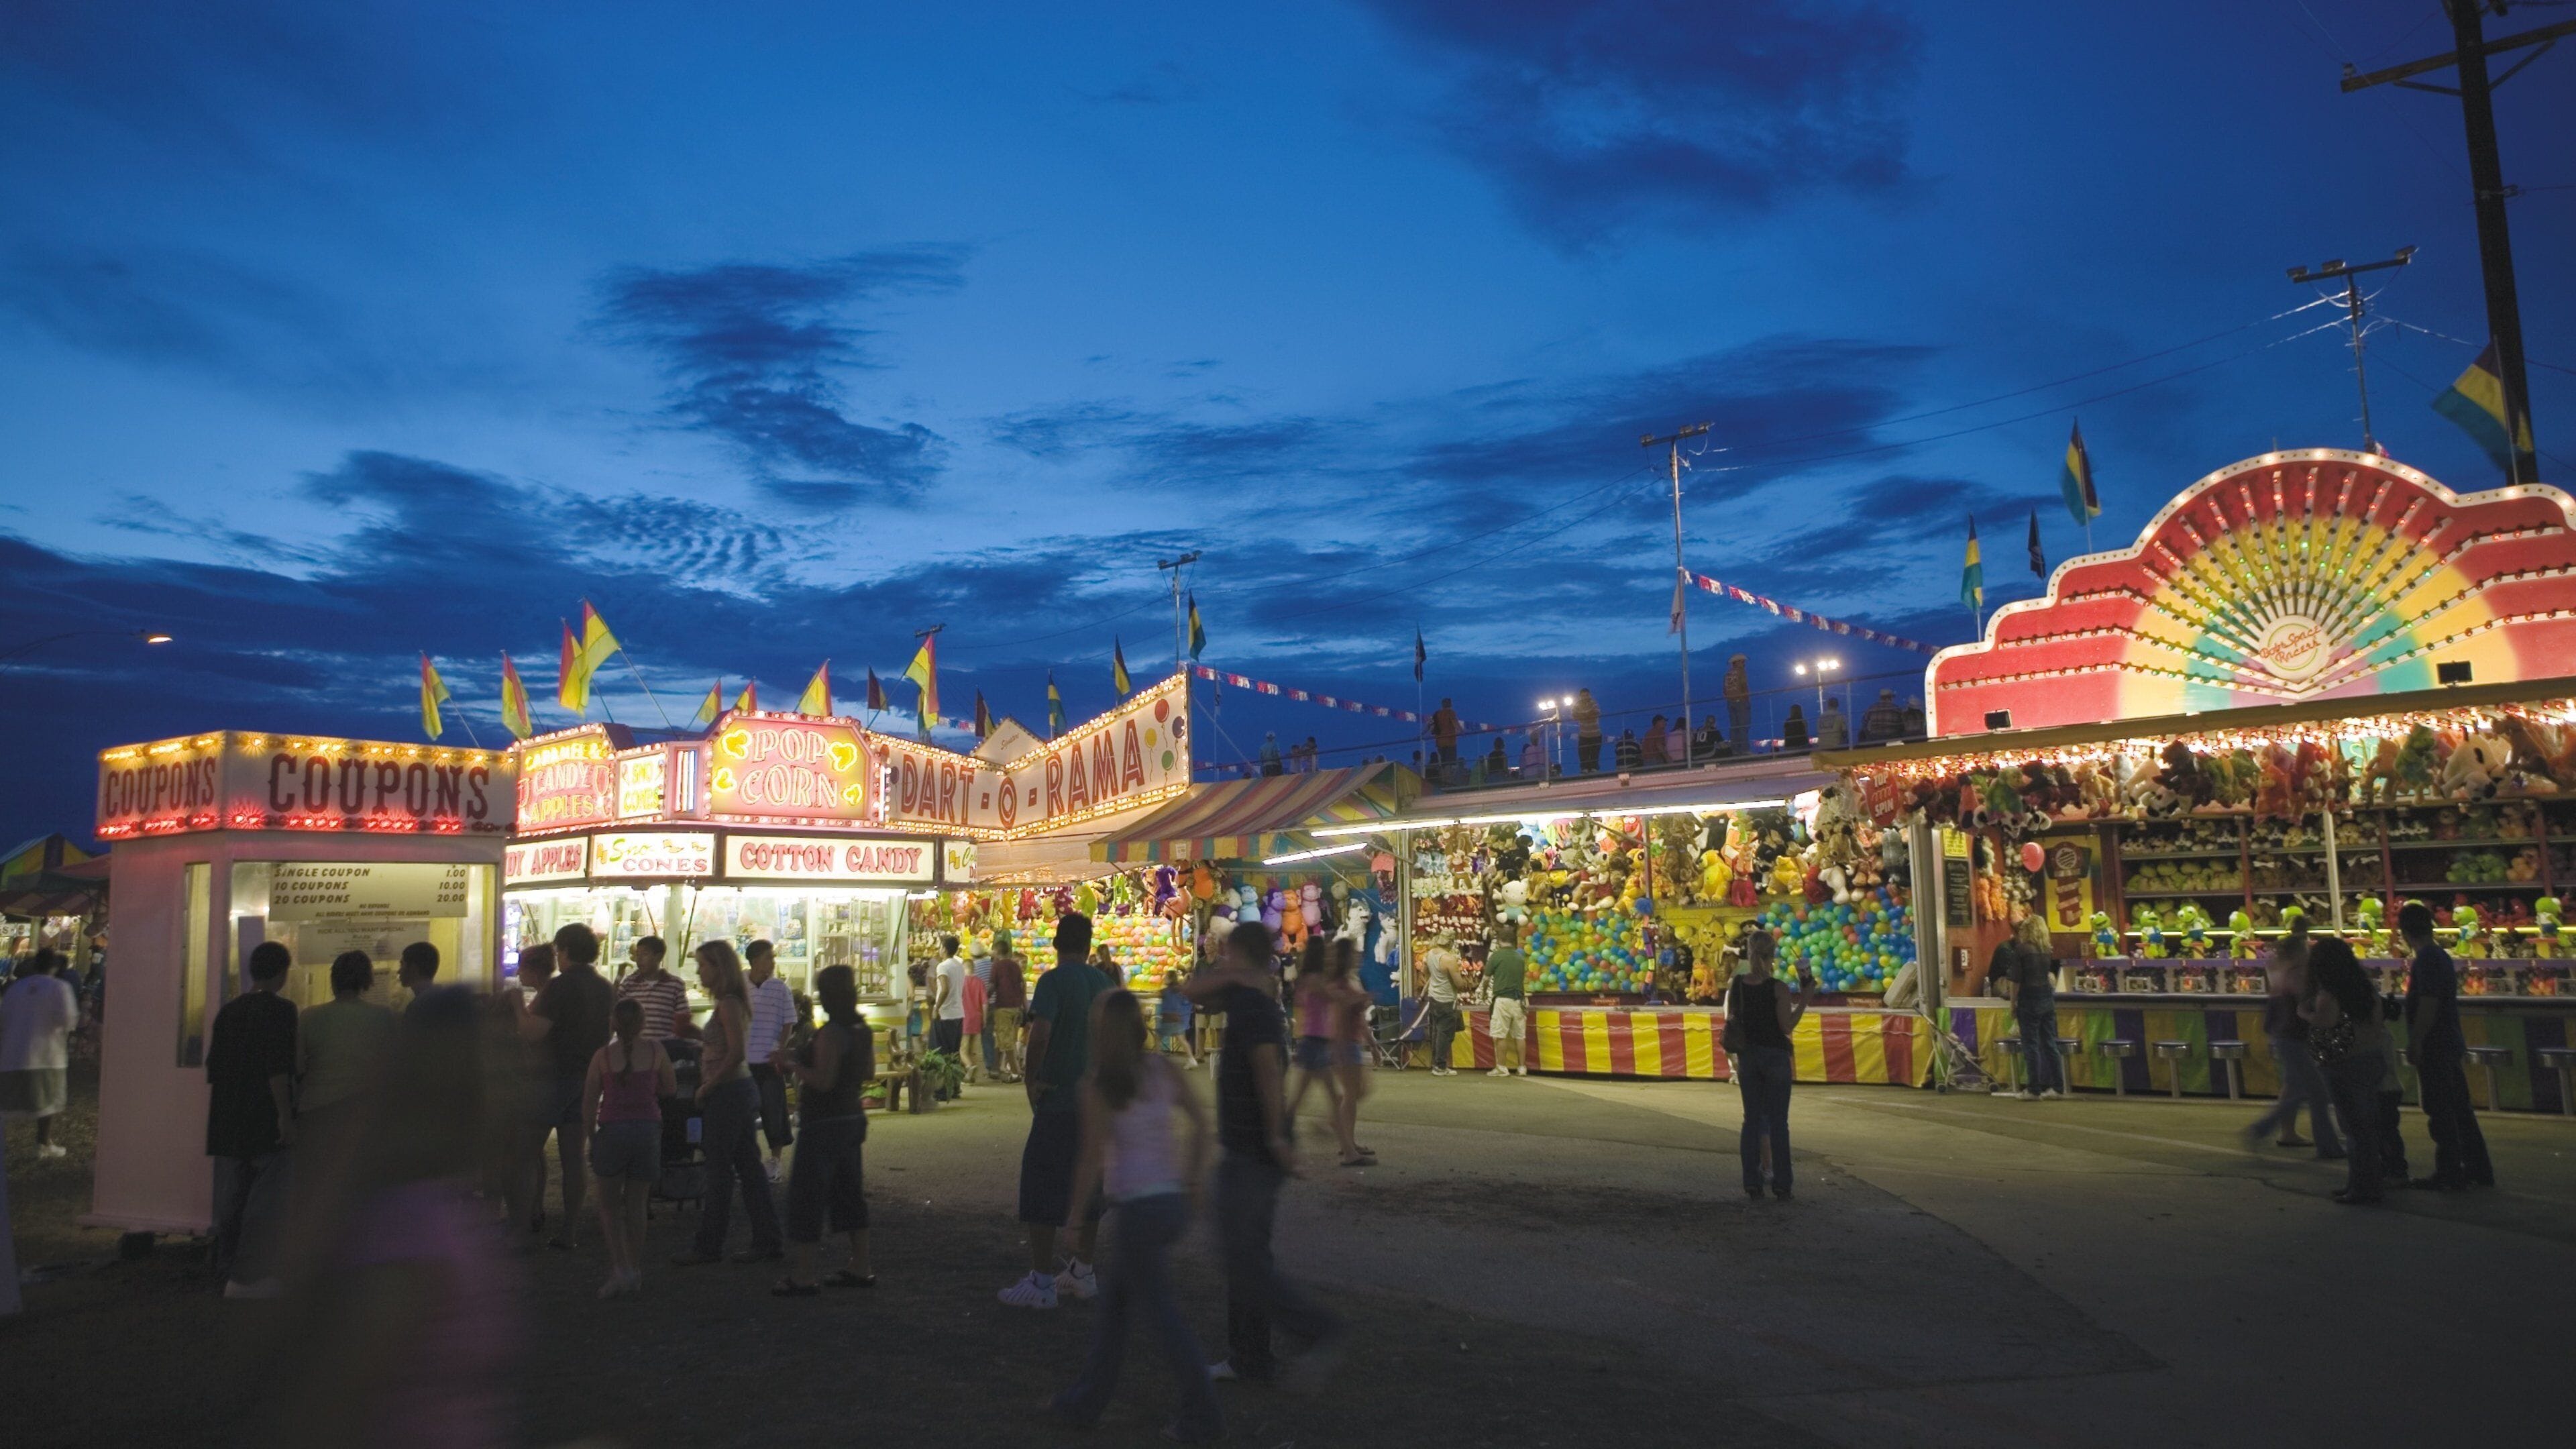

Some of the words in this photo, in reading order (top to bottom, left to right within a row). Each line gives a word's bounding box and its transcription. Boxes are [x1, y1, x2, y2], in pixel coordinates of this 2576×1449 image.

[525, 743, 588, 771] CARAMEL
[752, 728, 828, 764] POP
[532, 761, 591, 794] CANDY
[901, 754, 975, 824] DART
[1045, 718, 1144, 817] RAMA
[1874, 771, 1888, 788] TOP
[105, 756, 217, 818] COUPONS
[268, 753, 490, 820] COUPONS
[739, 764, 838, 808] CORN
[531, 795, 594, 824] APPLES
[1874, 798, 1894, 817] SPIN
[531, 844, 582, 875] APPLES
[609, 838, 653, 861] Sno
[740, 842, 835, 871] COTTON
[846, 845, 922, 873] CANDY
[274, 868, 319, 877] SINGLE
[321, 868, 370, 877] COUPON
[446, 869, 466, 877] 1.00
[623, 858, 708, 872] CONES
[274, 881, 288, 891] 10
[292, 881, 349, 890] COUPONS
[439, 881, 466, 890] 10.00
[274, 895, 289, 904] 20
[293, 894, 350, 904] COUPONS
[437, 894, 465, 902] 20.00
